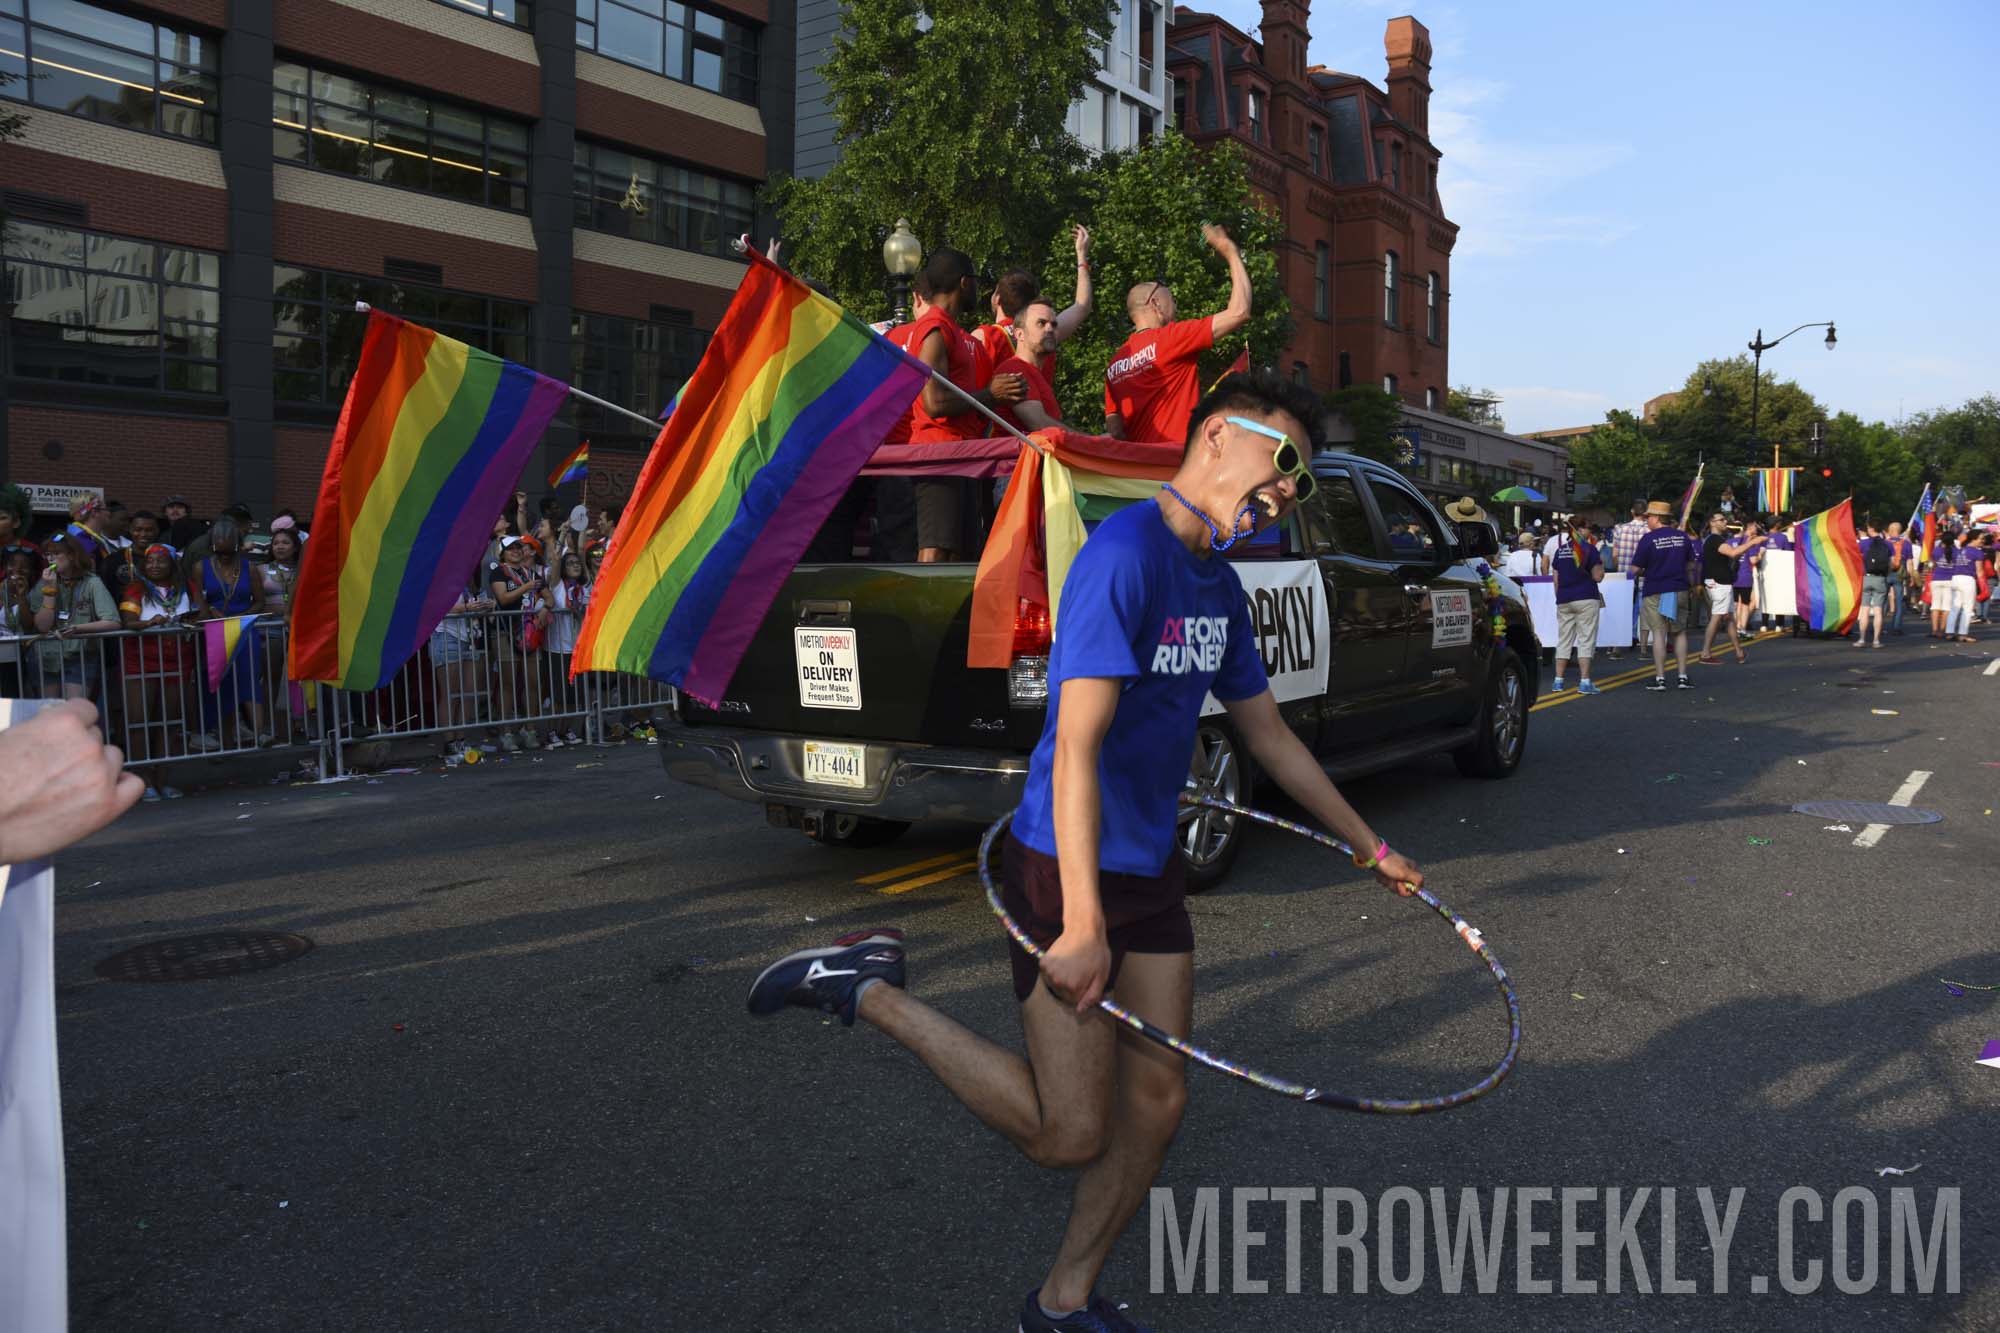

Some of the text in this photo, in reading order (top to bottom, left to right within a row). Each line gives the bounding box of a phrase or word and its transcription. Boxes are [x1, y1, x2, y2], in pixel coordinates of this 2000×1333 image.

[1436, 615, 1470, 628] ON DELIVERY
[819, 651, 834, 665] ON
[803, 666, 853, 682] DELIVERY
[810, 683, 850, 693] Driver Makes
[808, 692, 854, 704] Frequent Stops
